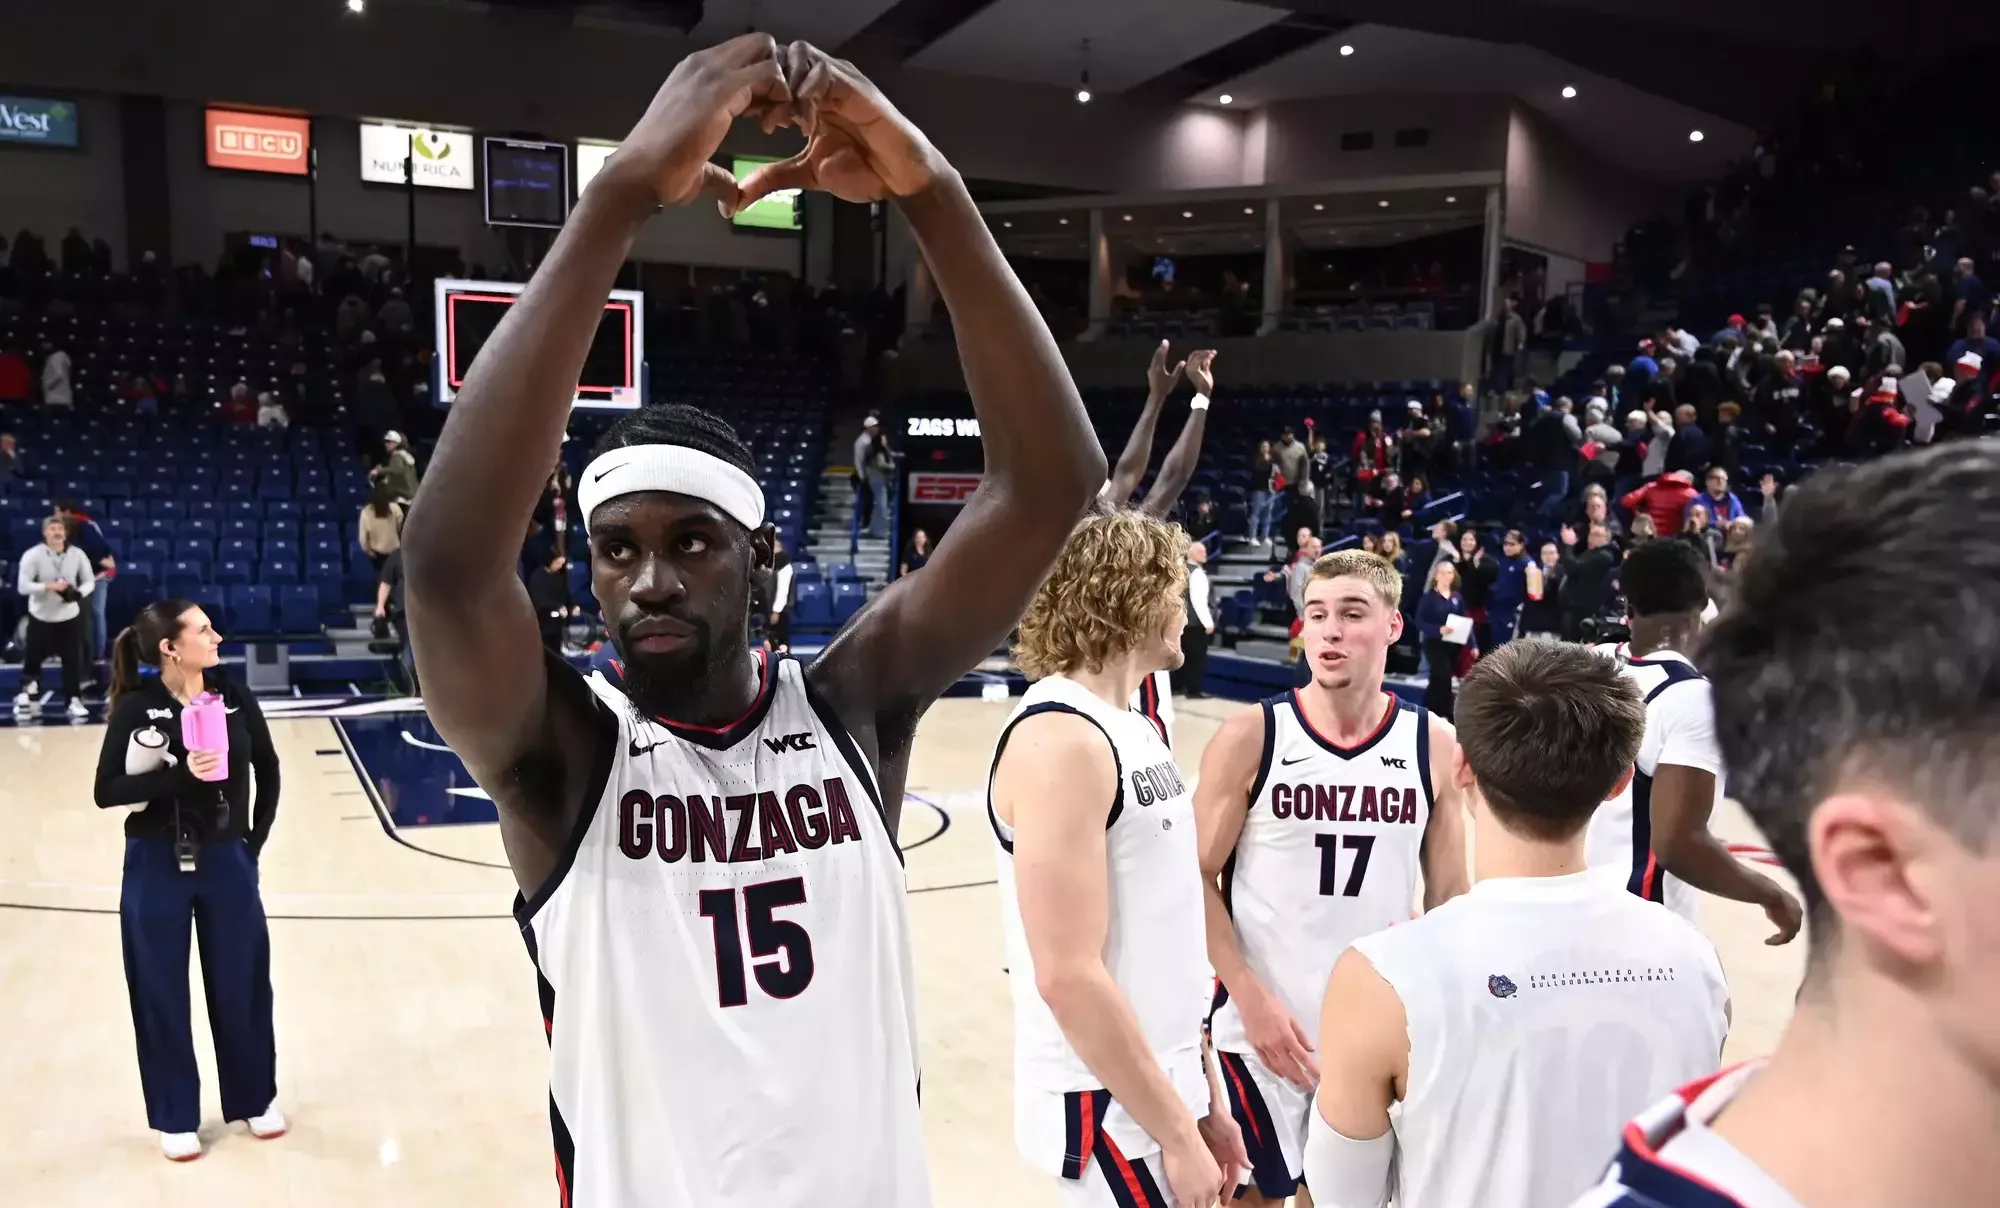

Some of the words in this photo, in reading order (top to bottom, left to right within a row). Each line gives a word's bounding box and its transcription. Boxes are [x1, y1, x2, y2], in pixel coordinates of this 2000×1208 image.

[908, 418, 954, 436] ZAGS
[914, 476, 981, 500] ESP
[764, 732, 816, 755] WCC
[1380, 756, 1407, 769] WCC
[1272, 783, 1417, 824] GONZAGA
[619, 777, 862, 864] GONZAGA
[1314, 833, 1377, 897] 17
[699, 876, 815, 1008] 15
[1530, 968, 1632, 982] ENGINEERED
[1598, 974, 1674, 984] BASKETBALL
